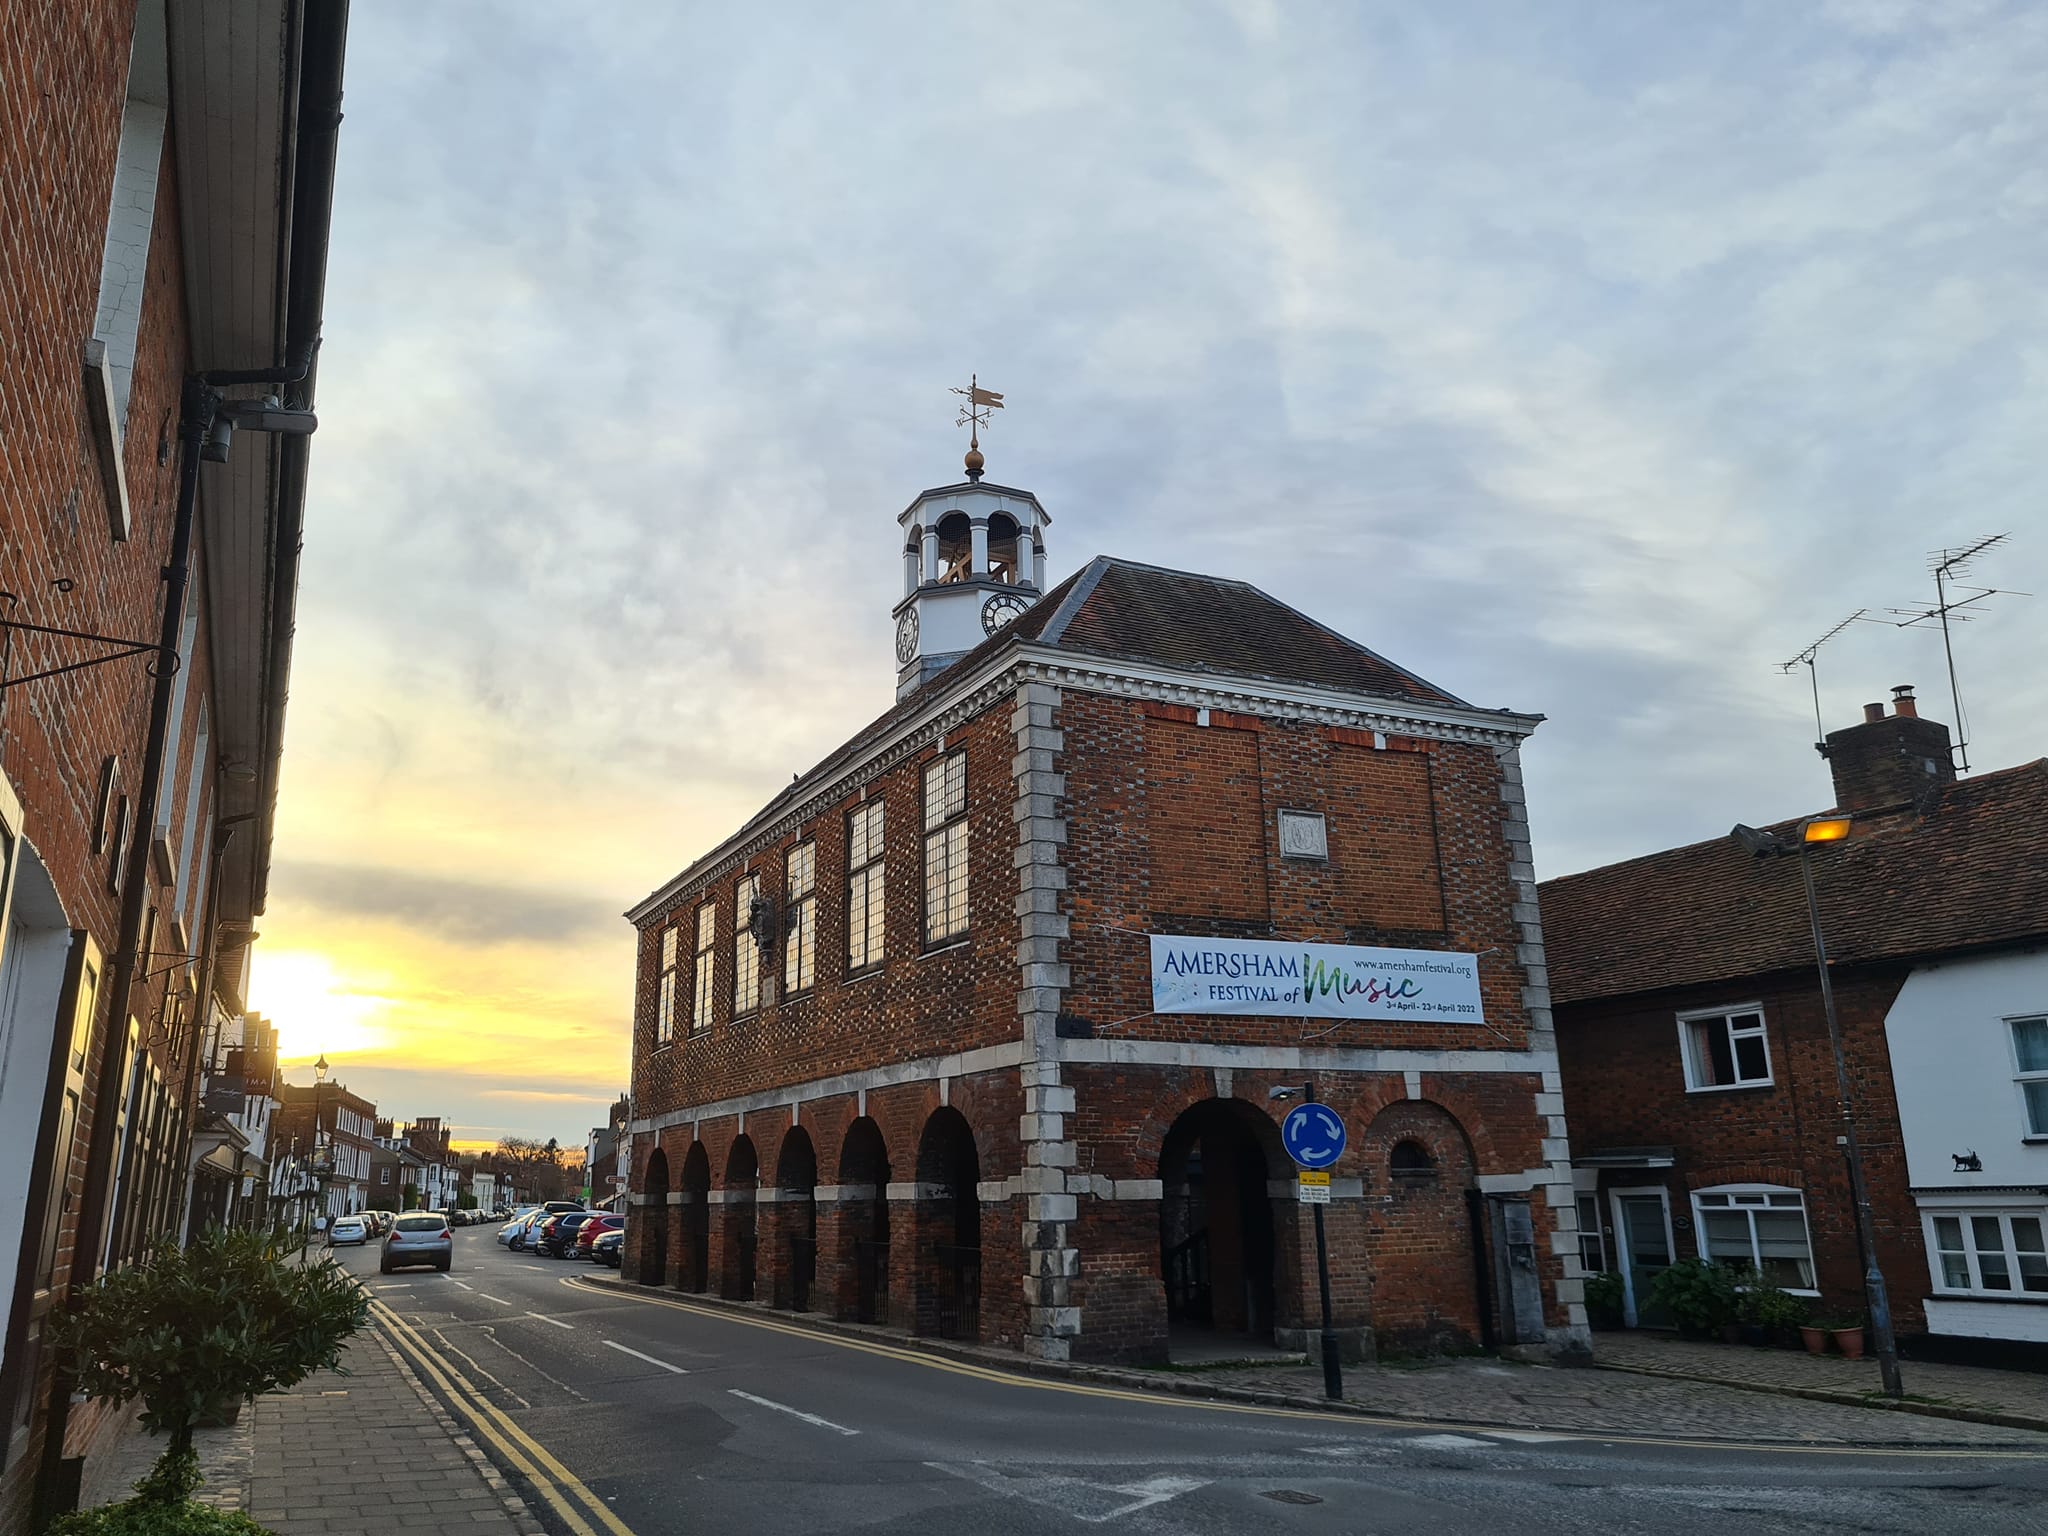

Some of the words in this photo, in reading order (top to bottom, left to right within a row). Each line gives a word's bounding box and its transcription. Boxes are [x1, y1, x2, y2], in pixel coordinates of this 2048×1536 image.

[1163, 950, 1300, 979] AMERSHAM
[1354, 959, 1471, 979] www.amershamfestival.org
[1303, 953, 1423, 1004] Music
[1209, 984, 1279, 1002] FESTIVAL
[1284, 987, 1301, 1004] of
[1397, 1001, 1416, 1012] April
[1437, 1003, 1456, 1013] April
[1457, 1004, 1476, 1013] 2022
